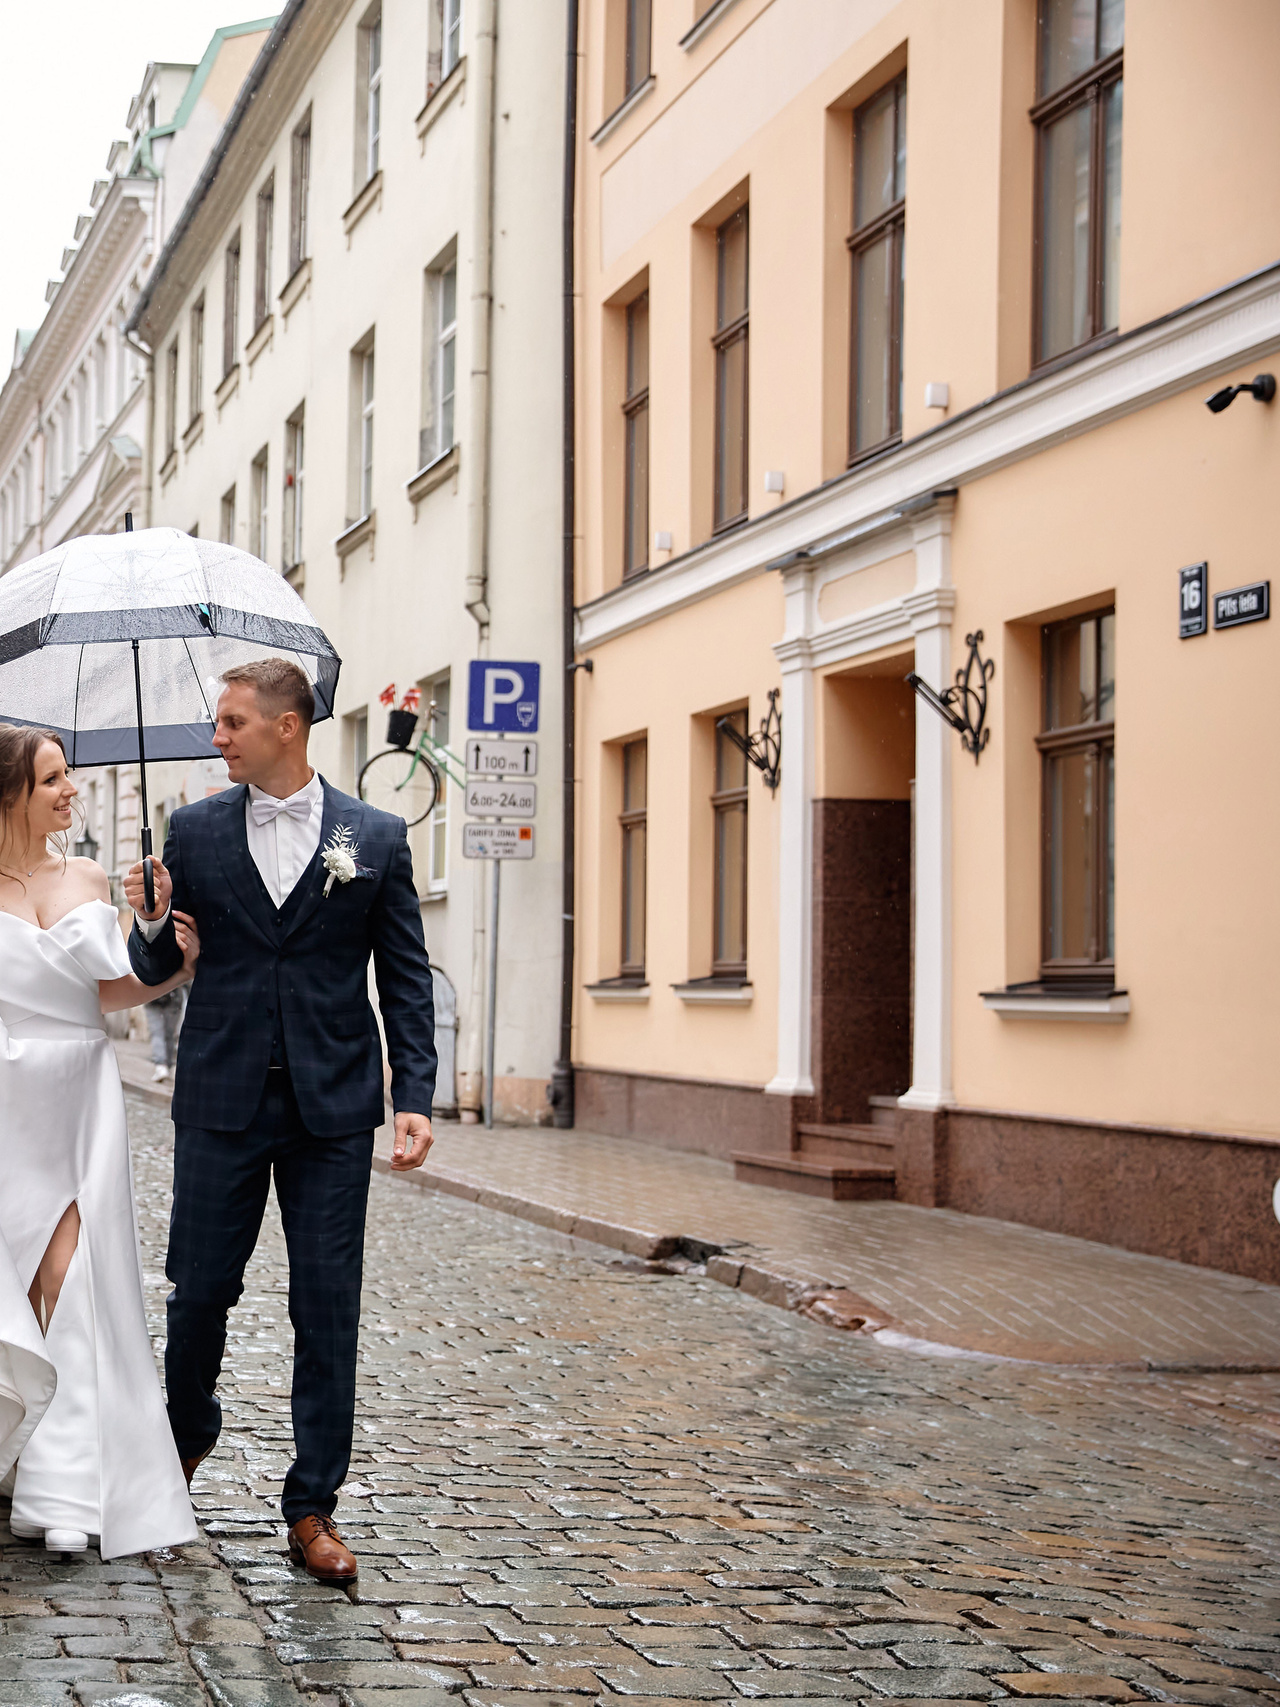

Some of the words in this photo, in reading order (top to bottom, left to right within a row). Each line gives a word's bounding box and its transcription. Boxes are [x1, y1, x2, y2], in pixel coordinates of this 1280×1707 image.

[1181, 579, 1201, 611] 16
[1218, 597, 1238, 619] Pils
[1239, 592, 1258, 613] iela
[483, 668, 525, 724] P
[485, 756, 506, 770] 100
[509, 762, 519, 770] m
